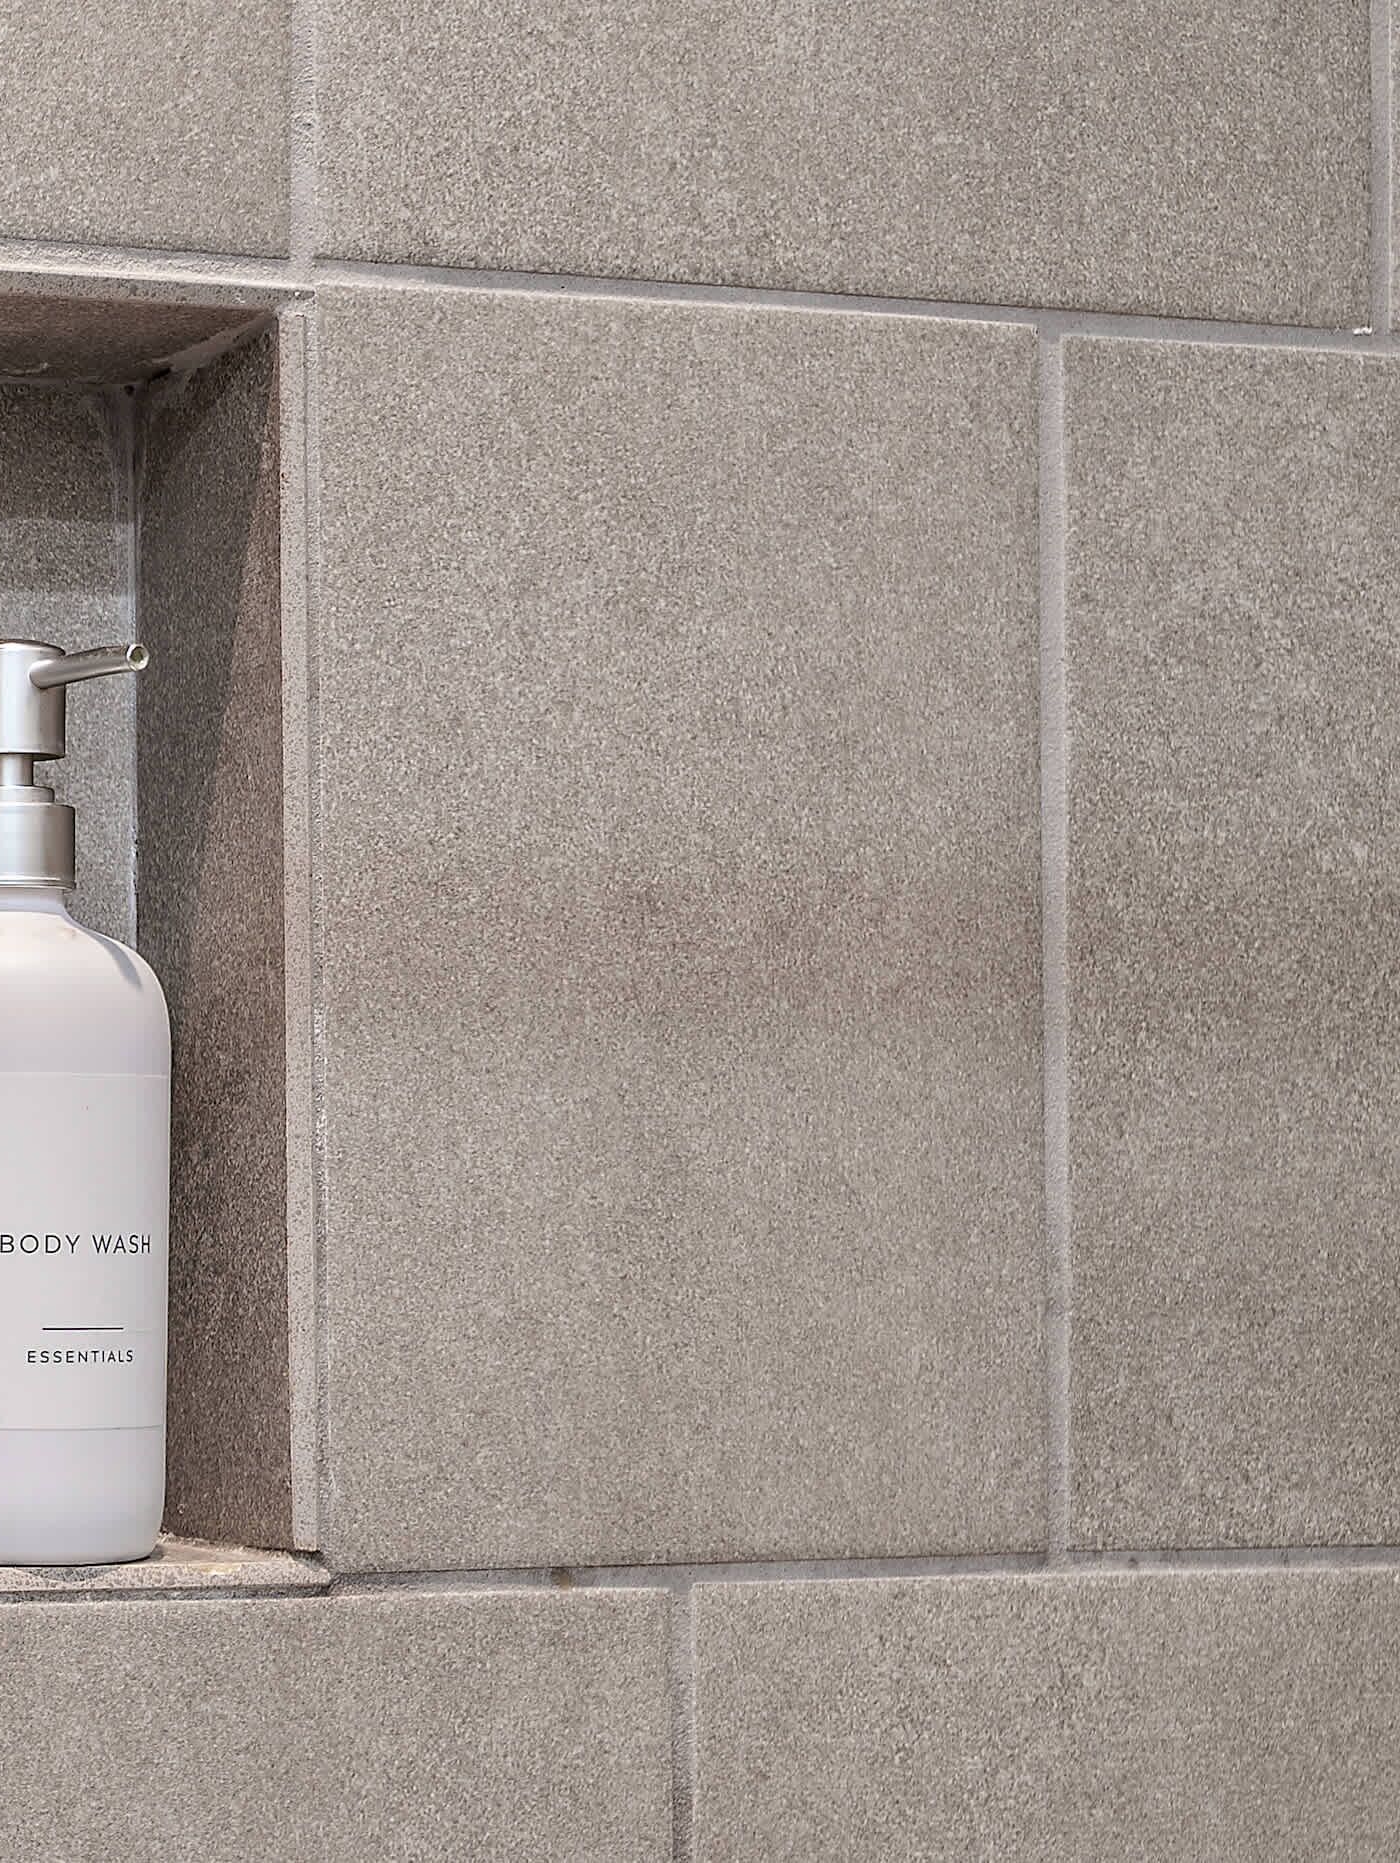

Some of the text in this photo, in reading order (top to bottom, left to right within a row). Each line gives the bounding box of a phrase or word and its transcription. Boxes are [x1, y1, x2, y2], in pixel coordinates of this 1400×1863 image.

[0, 1233, 152, 1255] BODY WASH
[27, 1349, 134, 1364] ESSENTIALS
